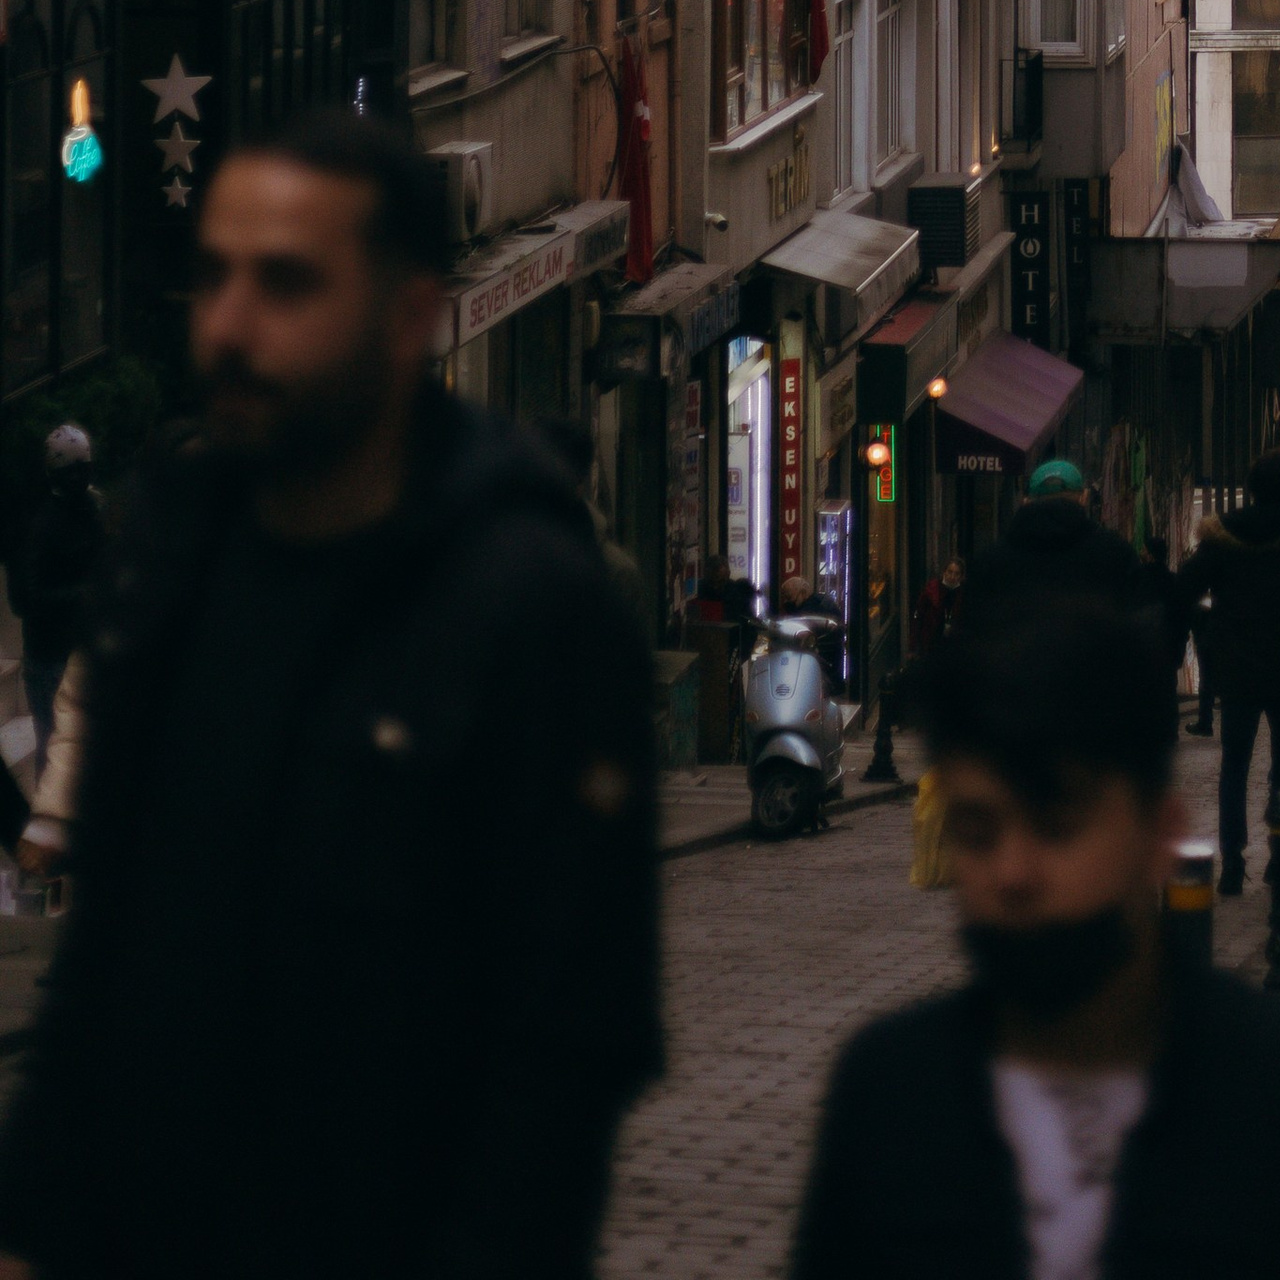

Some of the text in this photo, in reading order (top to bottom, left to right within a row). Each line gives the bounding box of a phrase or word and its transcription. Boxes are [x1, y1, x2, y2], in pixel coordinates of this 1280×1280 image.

[470, 246, 563, 329] SEVER REKLAM
[1019, 203, 1041, 344] HOTE
[784, 376, 798, 575] EKSEN UYD
[957, 454, 1003, 472] HOTEL
